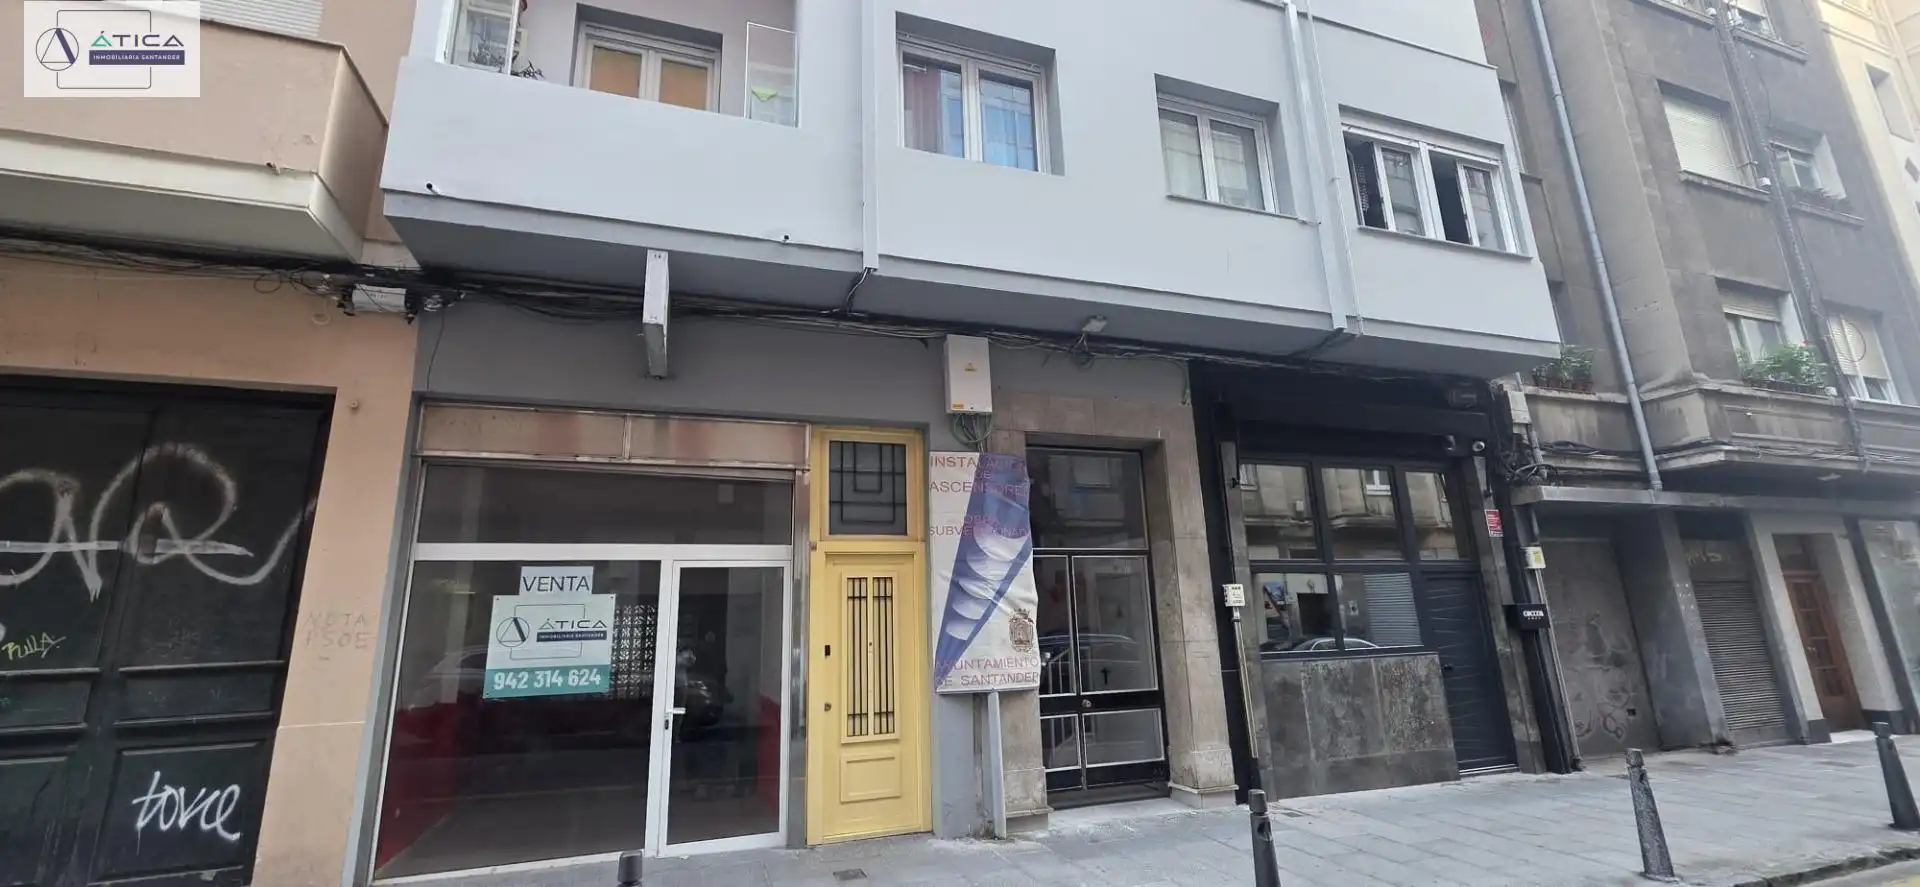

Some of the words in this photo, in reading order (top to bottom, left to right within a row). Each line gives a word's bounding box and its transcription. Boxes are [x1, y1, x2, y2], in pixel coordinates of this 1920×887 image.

[522, 576, 590, 592] VENTA
[537, 618, 607, 629] ÁTICA
[493, 671, 529, 690] 942
[533, 670, 563, 687] 314
[568, 667, 601, 686] 624
